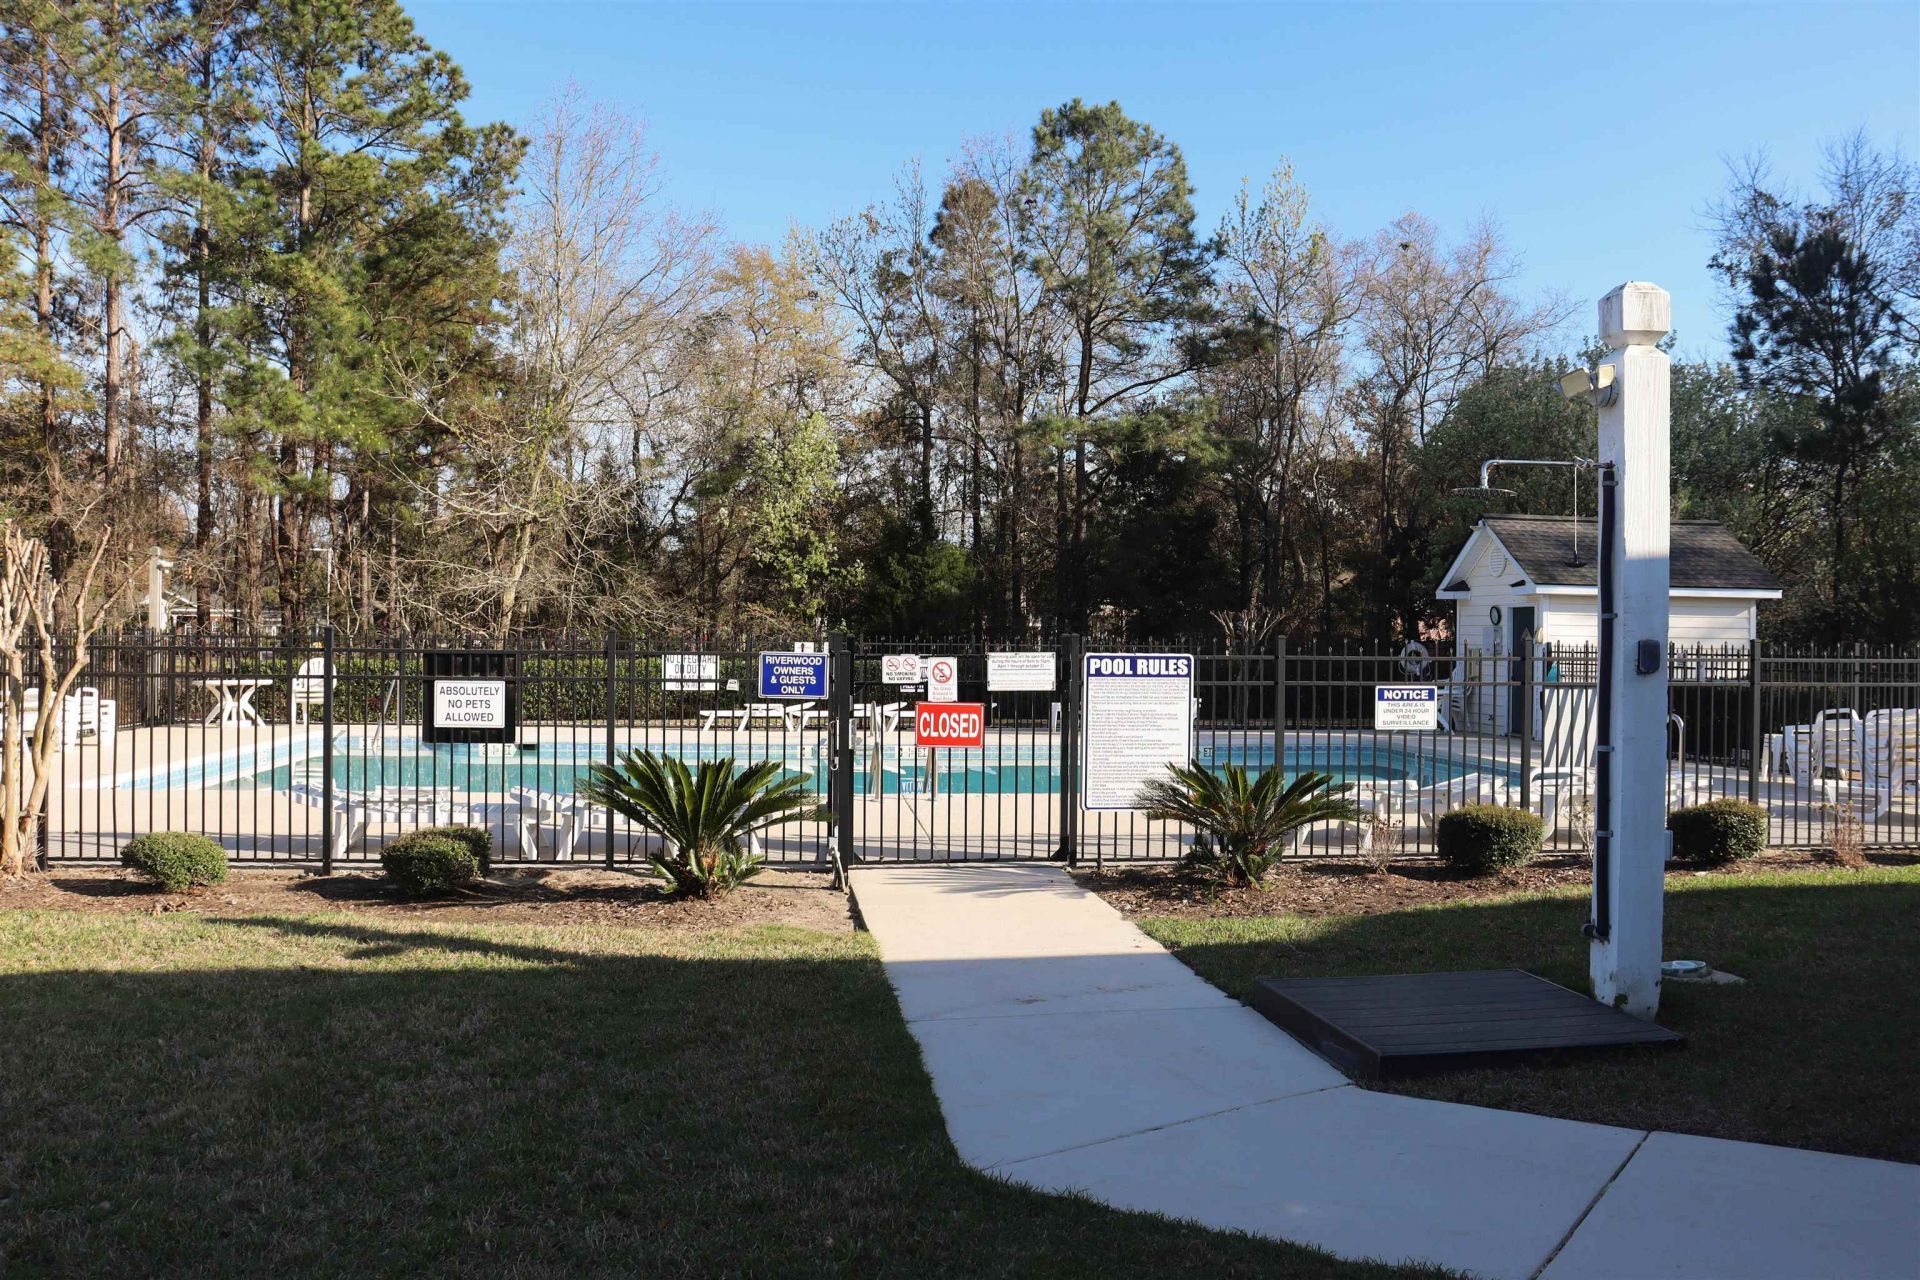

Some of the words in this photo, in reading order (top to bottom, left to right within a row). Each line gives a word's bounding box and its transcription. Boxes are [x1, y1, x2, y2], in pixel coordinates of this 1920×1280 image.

[676, 654, 717, 663] LFEGARD
[765, 656, 823, 666] RIVERWOOD
[687, 664, 707, 674] DUY
[773, 666, 814, 676] OWNERS
[1089, 658, 1133, 675] POOL
[1137, 658, 1189, 676] RULES
[770, 675, 778, 684] &
[780, 676, 817, 685] GUESTS
[439, 686, 500, 696] ABSOLUTELY
[781, 685, 806, 694] ONLY
[1383, 690, 1429, 700] NOTICE
[448, 699, 463, 709] NO
[465, 699, 491, 709] PETS
[444, 712, 494, 722] ALLOWED
[919, 711, 980, 738] CLOSED
